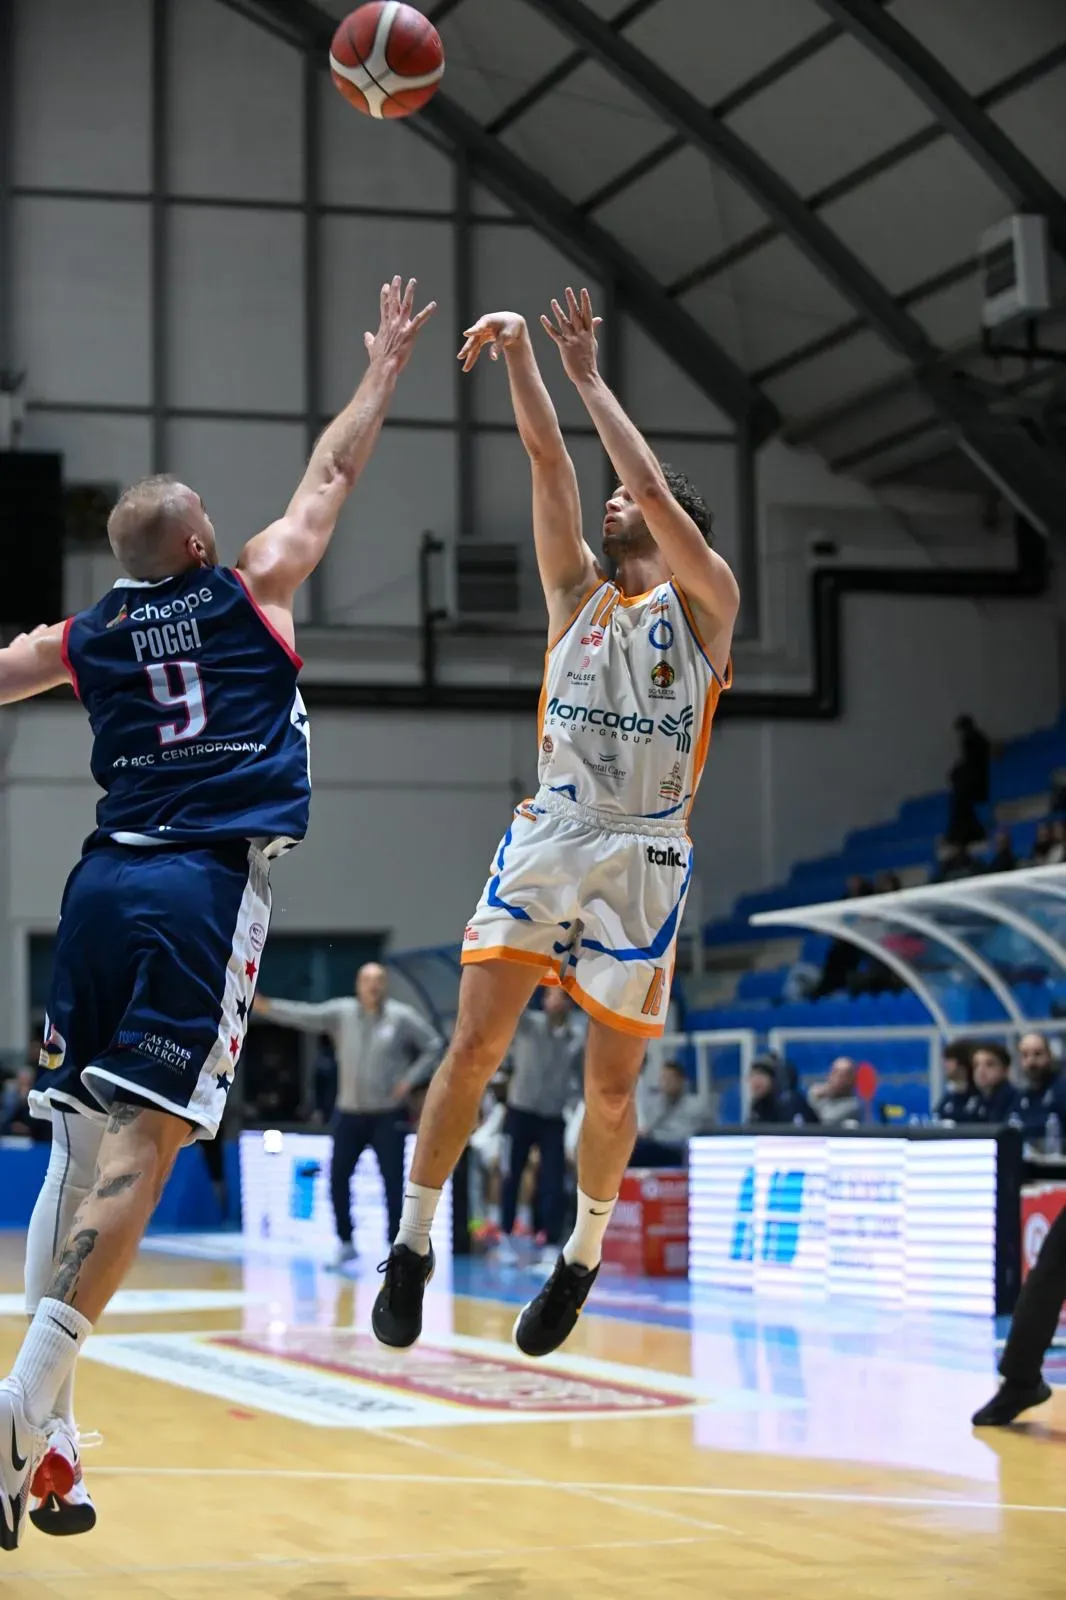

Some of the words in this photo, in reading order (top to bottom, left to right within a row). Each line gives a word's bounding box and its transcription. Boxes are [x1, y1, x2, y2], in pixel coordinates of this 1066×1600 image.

[131, 618, 202, 662] POGGI
[567, 671, 597, 682] PULSEE
[145, 661, 208, 745] 9
[547, 697, 654, 735] Moncada
[545, 719, 586, 732] ERGY
[599, 729, 652, 744] GROUP
[131, 754, 155, 767] BCC
[161, 742, 267, 761] CENTROPADANA
[163, 1039, 192, 1060] SALES
